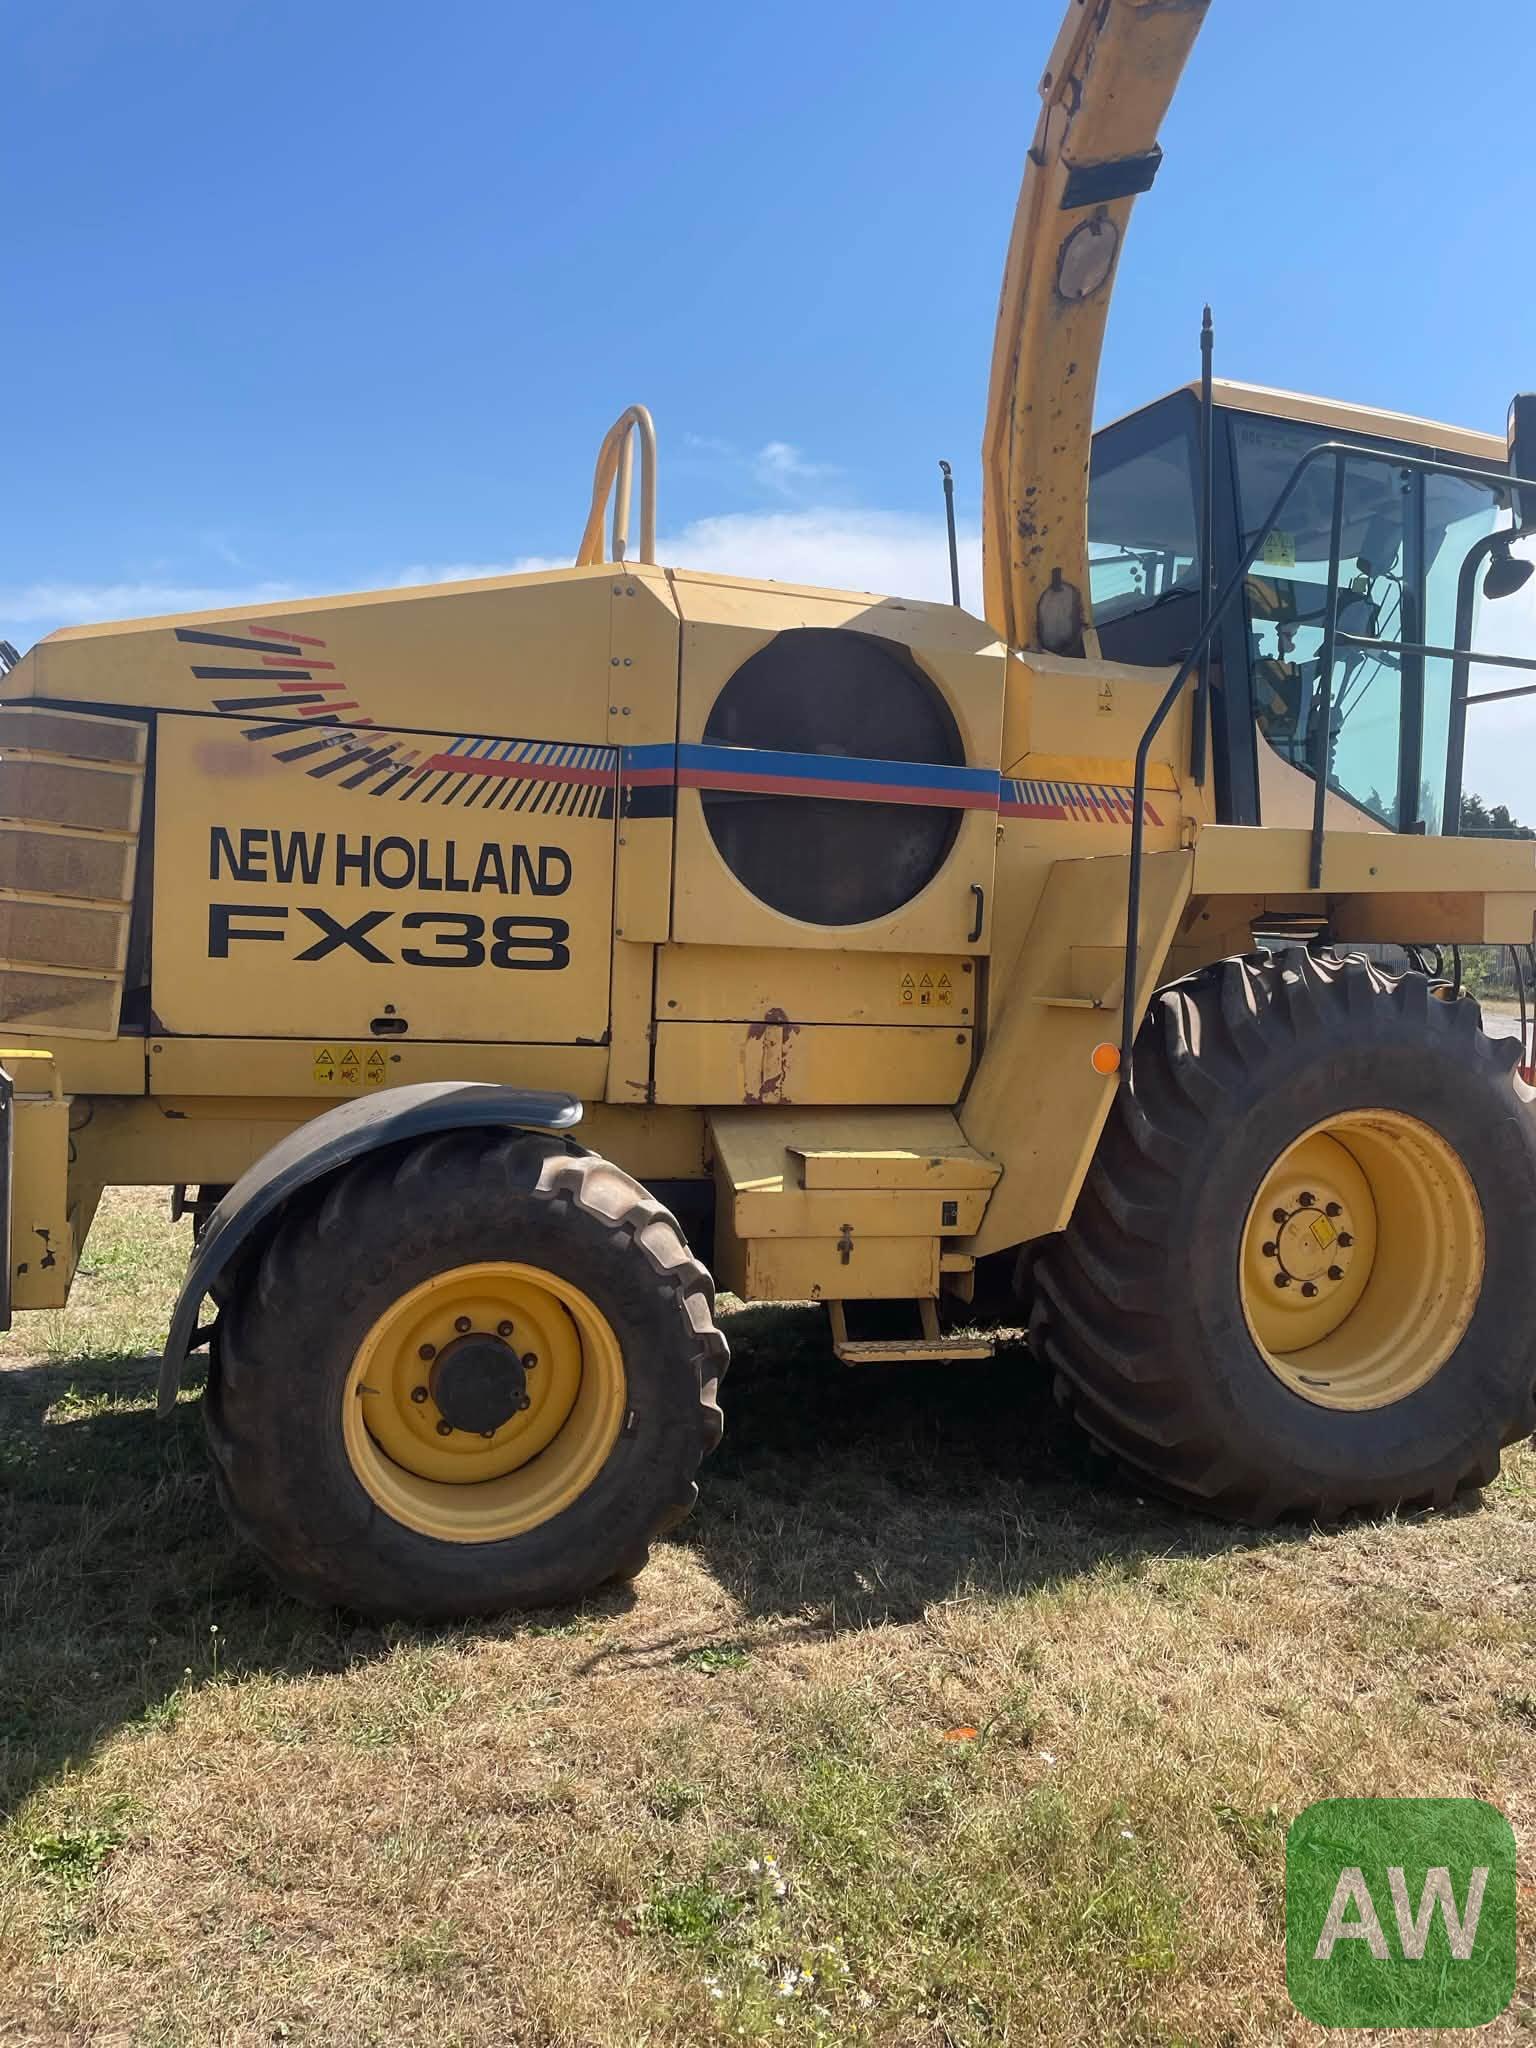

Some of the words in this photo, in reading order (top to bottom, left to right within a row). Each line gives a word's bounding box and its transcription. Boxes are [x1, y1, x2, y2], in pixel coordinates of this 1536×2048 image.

[209, 826, 326, 885] NEW
[335, 833, 572, 897] HOLLAND
[207, 903, 570, 970] FX38
